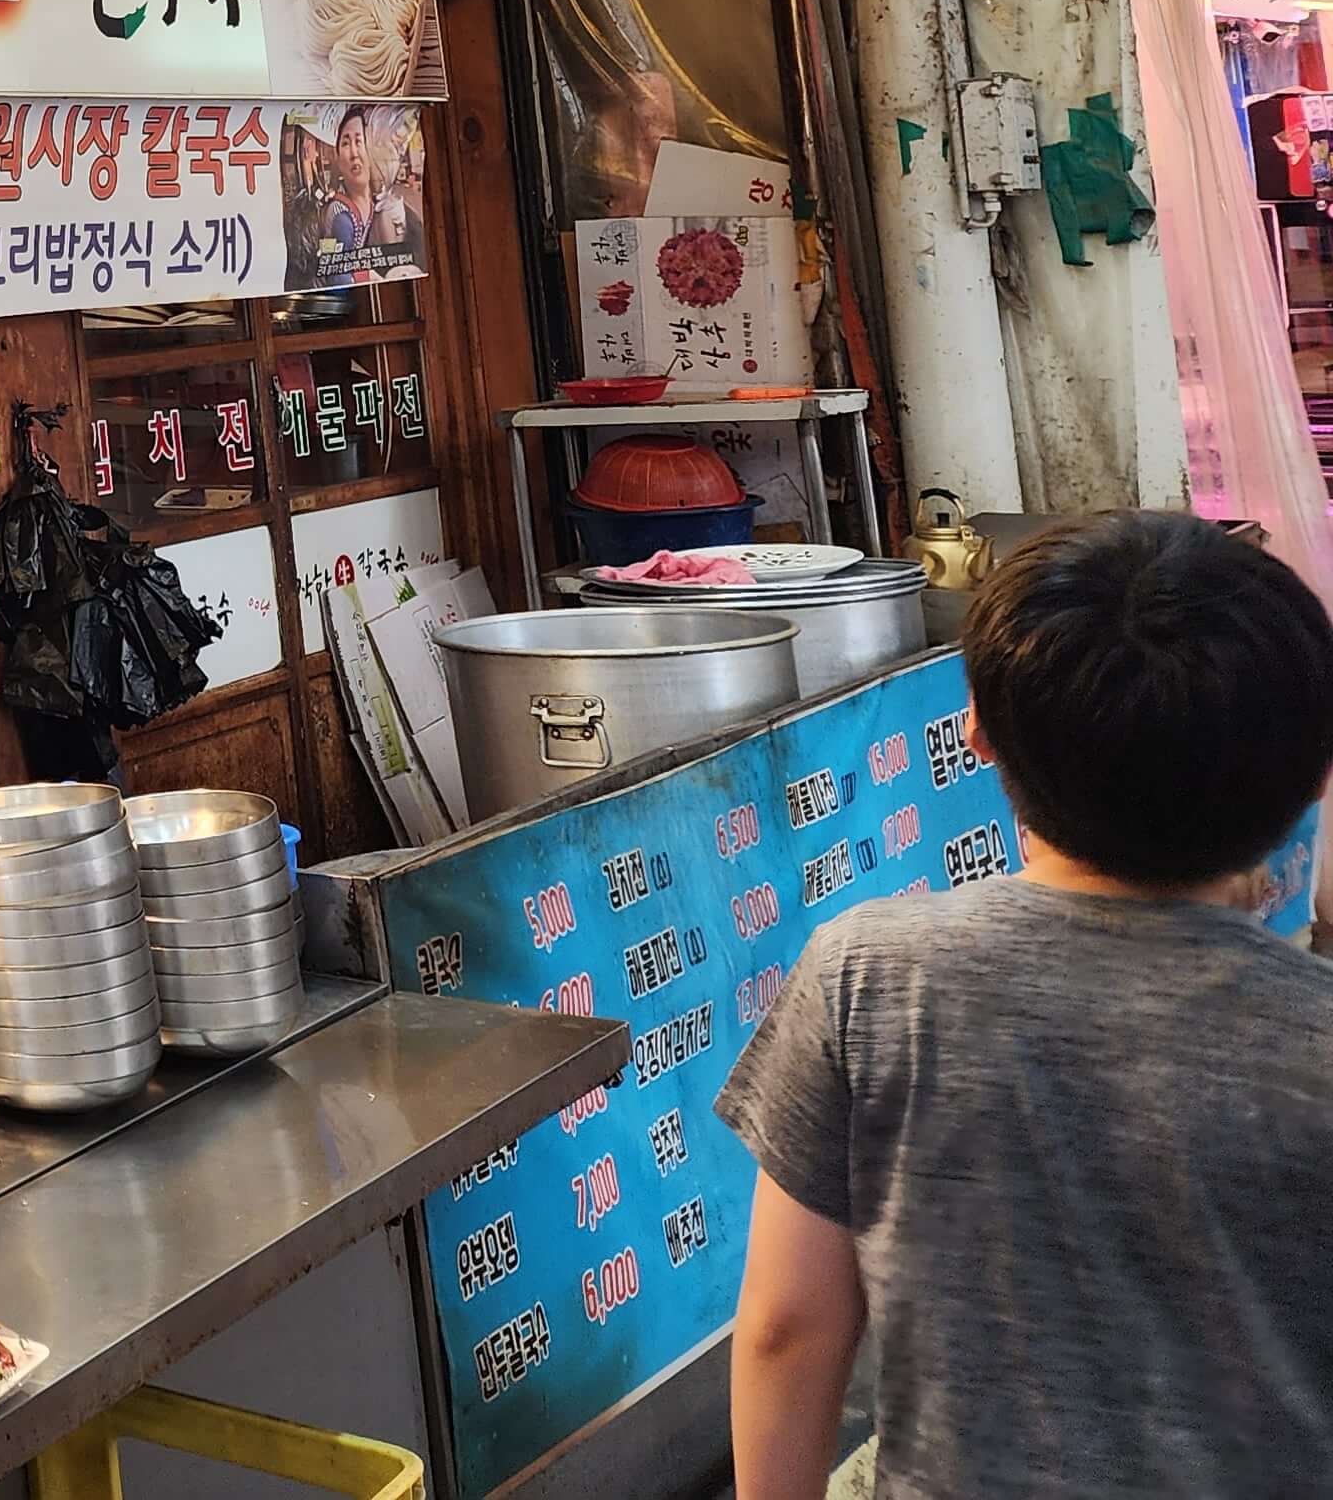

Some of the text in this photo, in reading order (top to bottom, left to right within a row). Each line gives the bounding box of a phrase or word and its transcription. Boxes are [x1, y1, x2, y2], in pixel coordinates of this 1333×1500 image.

[140, 105, 272, 199] 칼국수
[166, 212, 253, 286] 소개)
[277, 373, 426, 459] 해물파전
[601, 848, 650, 912] 김치전
[714, 800, 762, 860] 6,500
[416, 881, 577, 997] 칼국수 5,000
[624, 925, 685, 1000] 해물파전
[731, 881, 781, 941] 8,000
[571, 1152, 622, 1233] 7,000
[661, 1193, 710, 1269] 배추전
[457, 1210, 521, 1302] 유부오뎅
[582, 1245, 640, 1327] 6,000
